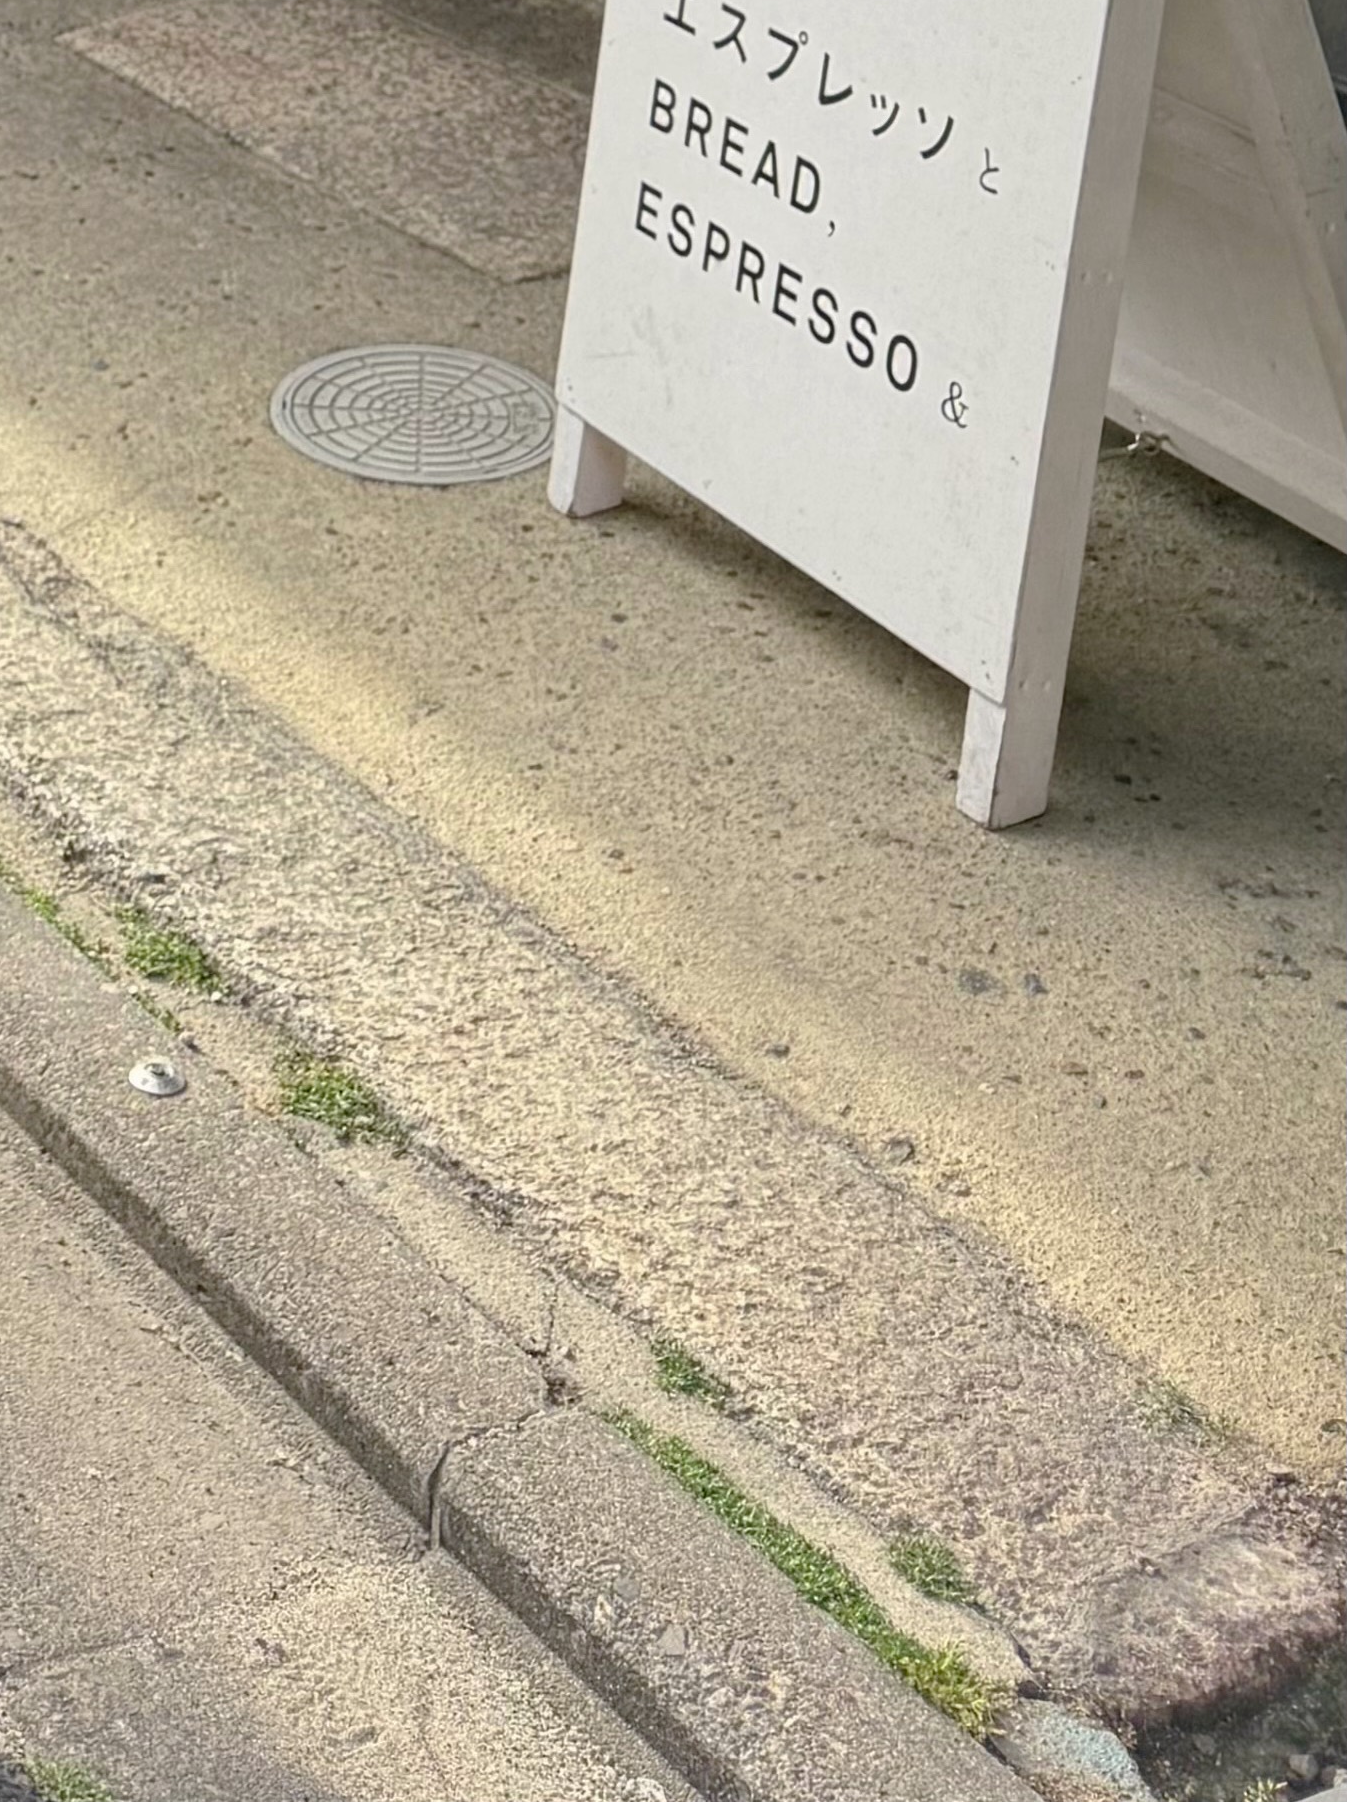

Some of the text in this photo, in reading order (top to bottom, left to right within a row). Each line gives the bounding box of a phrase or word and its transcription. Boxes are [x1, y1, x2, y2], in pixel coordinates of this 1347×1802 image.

[649, 78, 836, 236] BREAD,
[635, 181, 968, 429] ESPRESSO &
